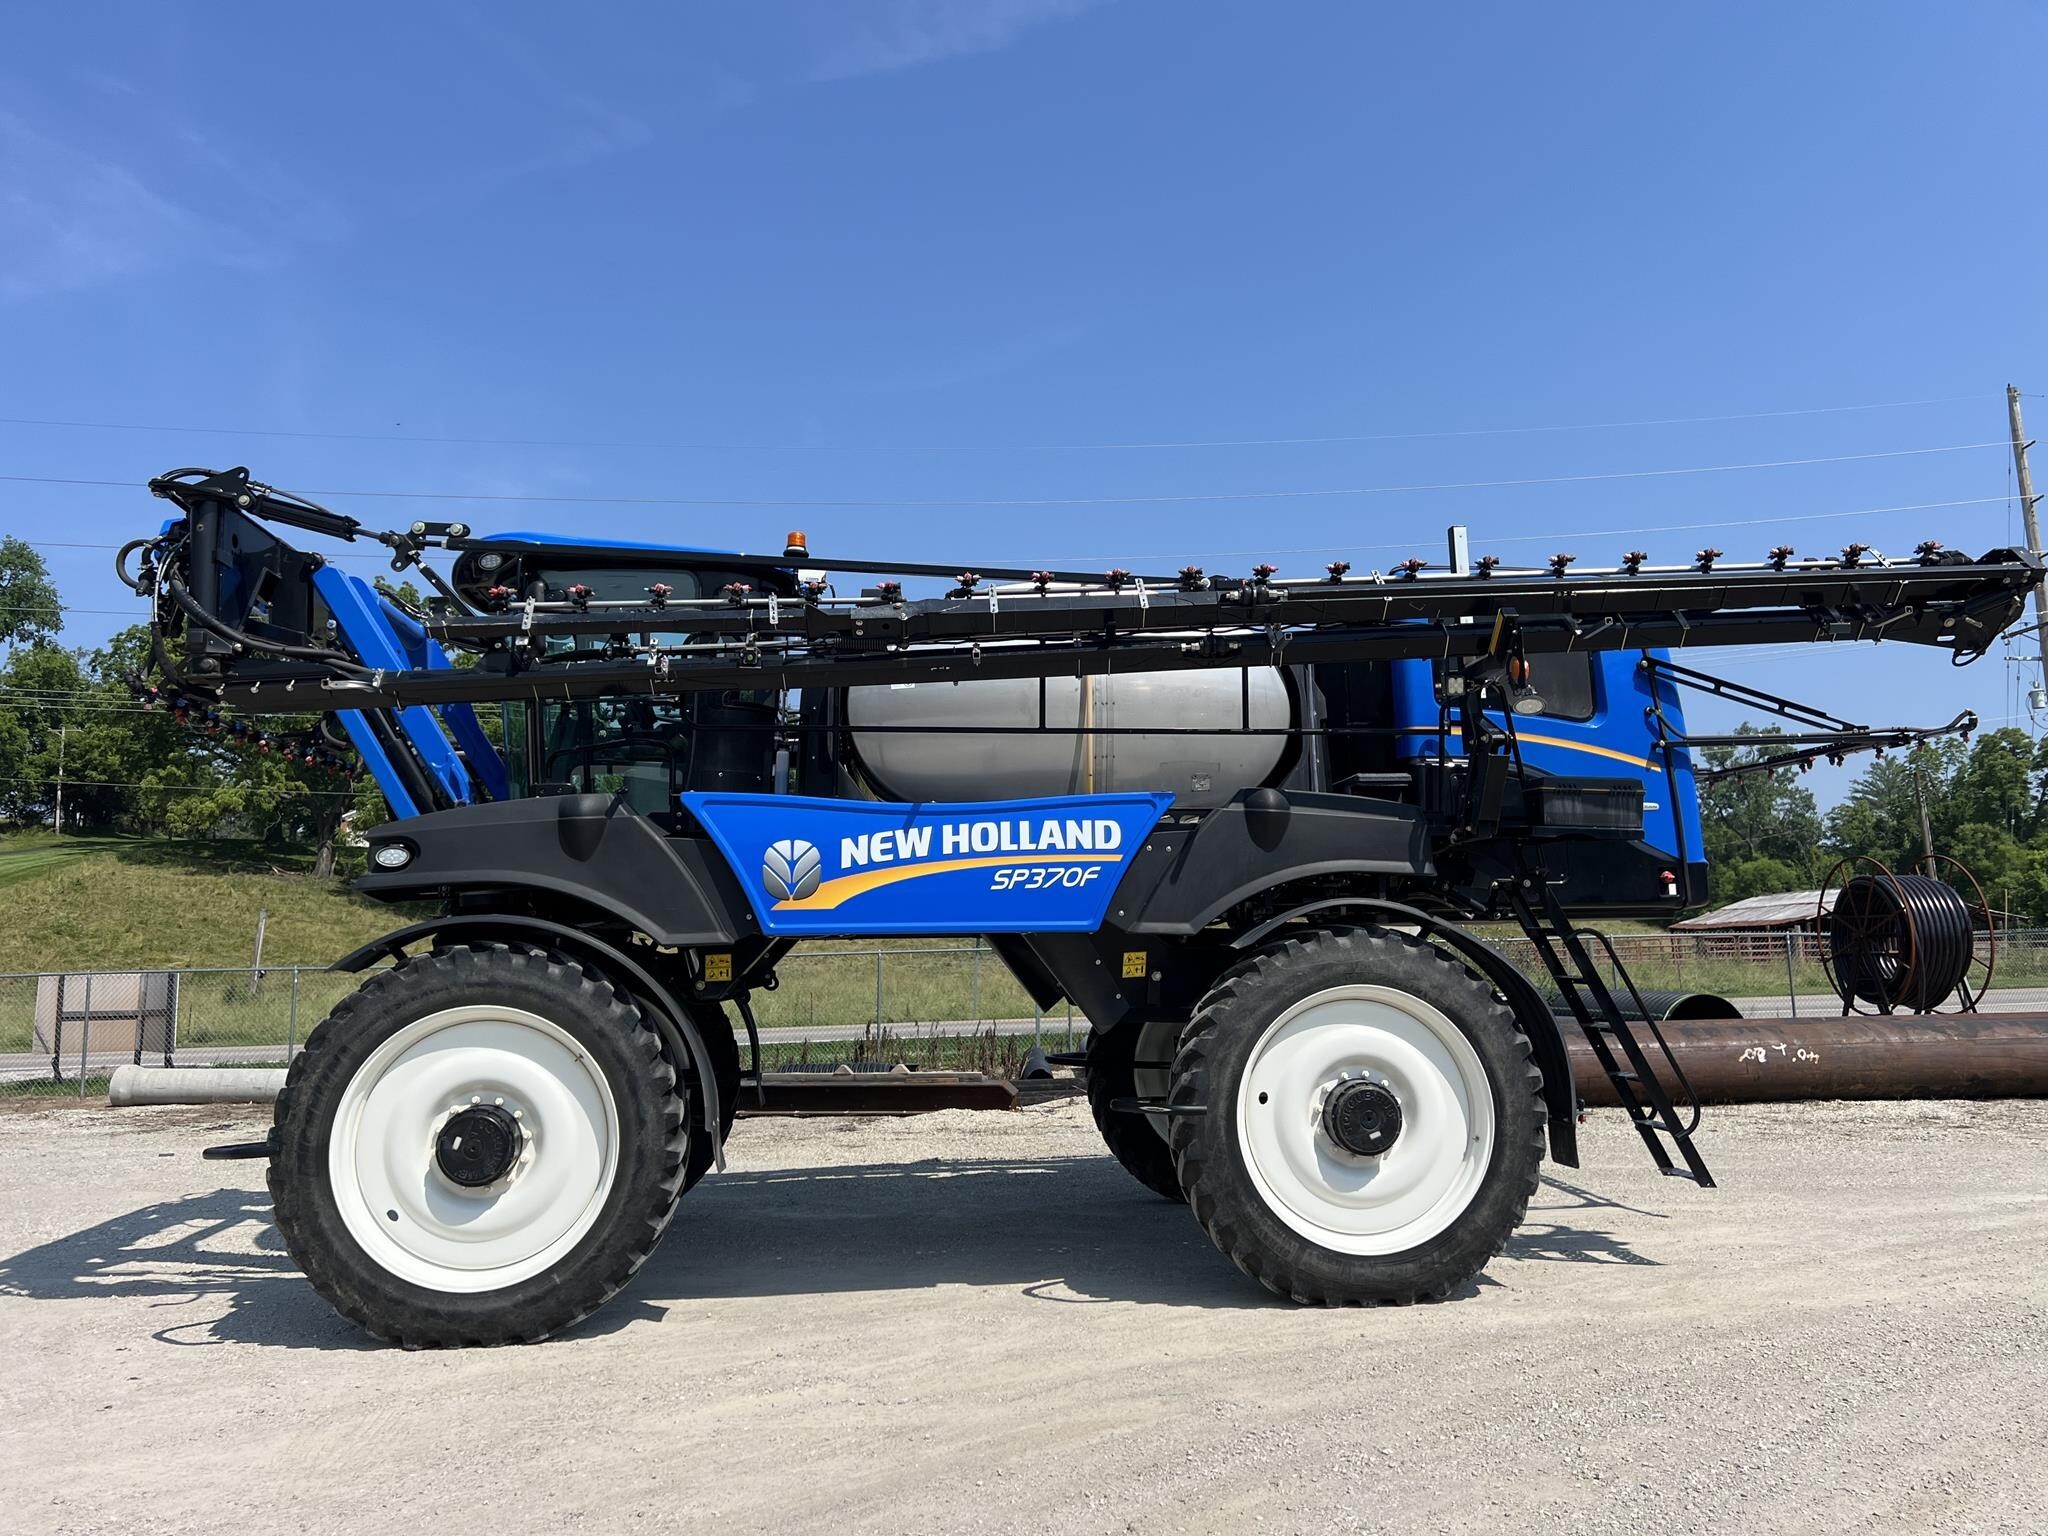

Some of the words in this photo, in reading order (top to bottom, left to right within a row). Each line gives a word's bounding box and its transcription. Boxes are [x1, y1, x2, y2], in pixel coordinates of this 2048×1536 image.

[840, 826, 933, 870] NEW
[942, 819, 1122, 855] HOLLAND
[990, 866, 1102, 890] SP370F
